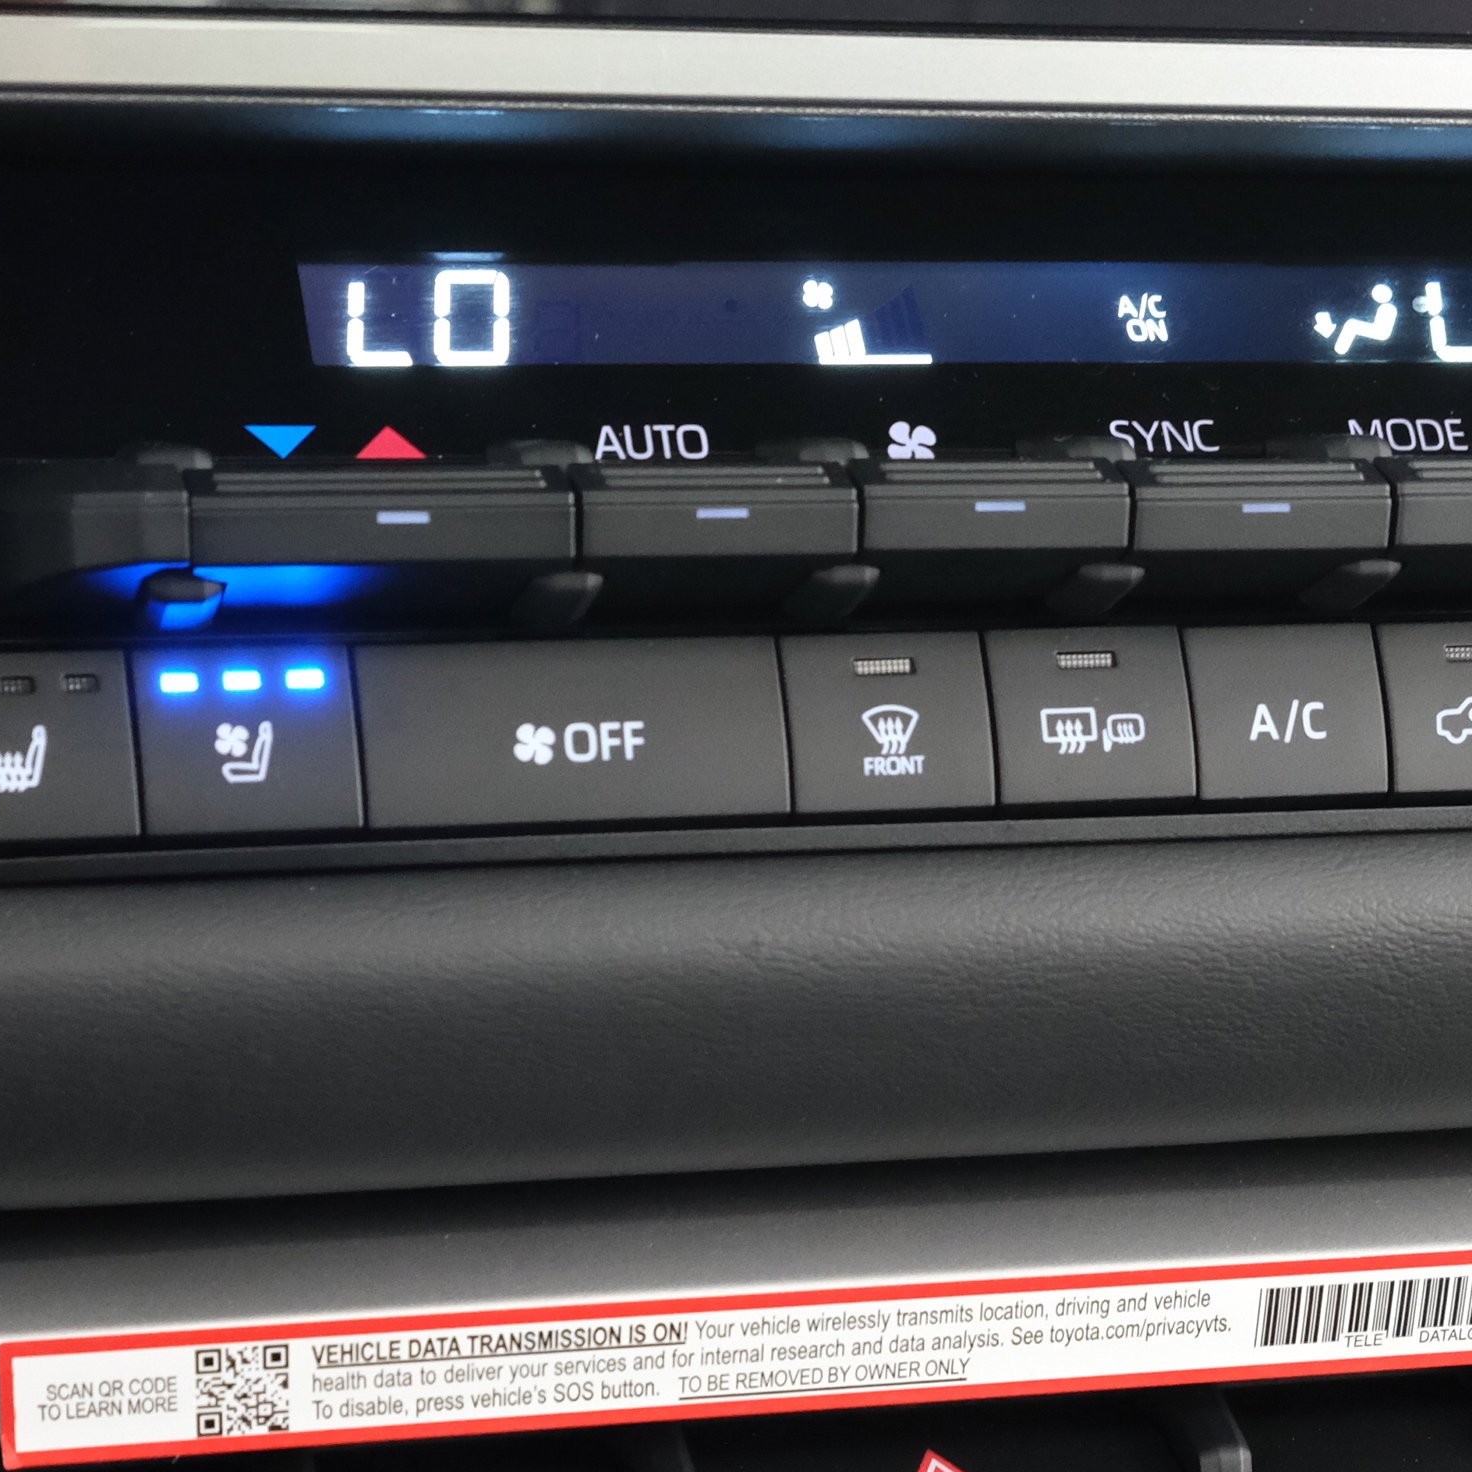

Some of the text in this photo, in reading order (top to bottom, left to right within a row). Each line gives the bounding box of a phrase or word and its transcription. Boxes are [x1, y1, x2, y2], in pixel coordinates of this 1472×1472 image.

[1118, 293, 1167, 319] A/C
[1126, 317, 1169, 342] ON
[594, 424, 709, 461] AUTO
[1108, 419, 1220, 453] SYNC
[1347, 418, 1470, 453] MODE
[1248, 699, 1328, 744] A/C
[563, 721, 645, 763] OFF
[863, 755, 925, 777] FRONT
[312, 1289, 1211, 1365] VEHICLE DATA TRANSMISSION IS ON! Your vehicle wirelessly transmits location, driving and vehicle
[1344, 1332, 1384, 1348] TELE
[312, 1313, 1232, 1393] health data to deliver your services and for internal research and data analysis. See toyota.com/privacyvts.
[45, 1375, 178, 1402] SCAN QR CODE
[312, 1357, 971, 1420] To disable, press vehicle's SOS button. TO BE REMOVED BY OWNER ONLY
[38, 1395, 178, 1422] TO LEARN MORE
